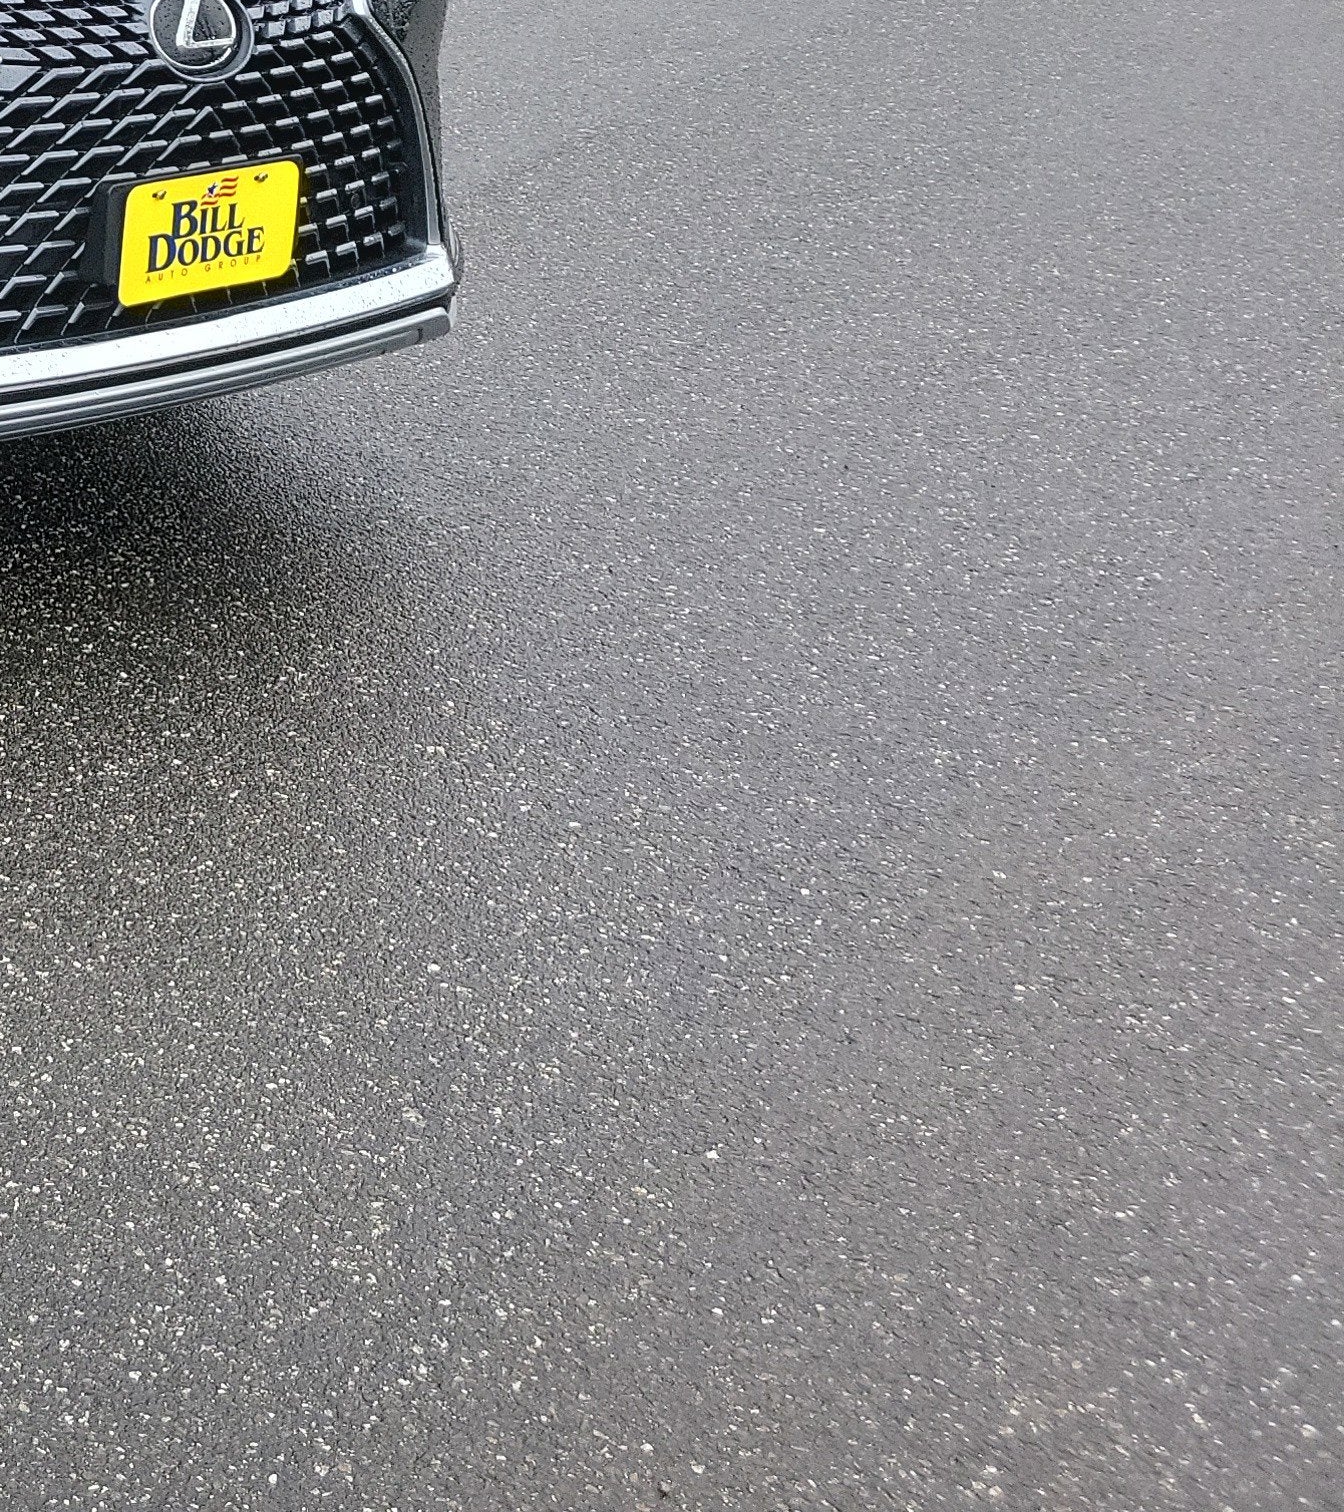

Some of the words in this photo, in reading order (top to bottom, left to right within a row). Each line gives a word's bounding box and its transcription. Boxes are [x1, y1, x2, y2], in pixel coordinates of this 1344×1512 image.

[172, 199, 245, 239] BILL
[145, 226, 265, 274] DODGE
[145, 267, 189, 284] AUTO
[204, 254, 262, 272] GROUP
